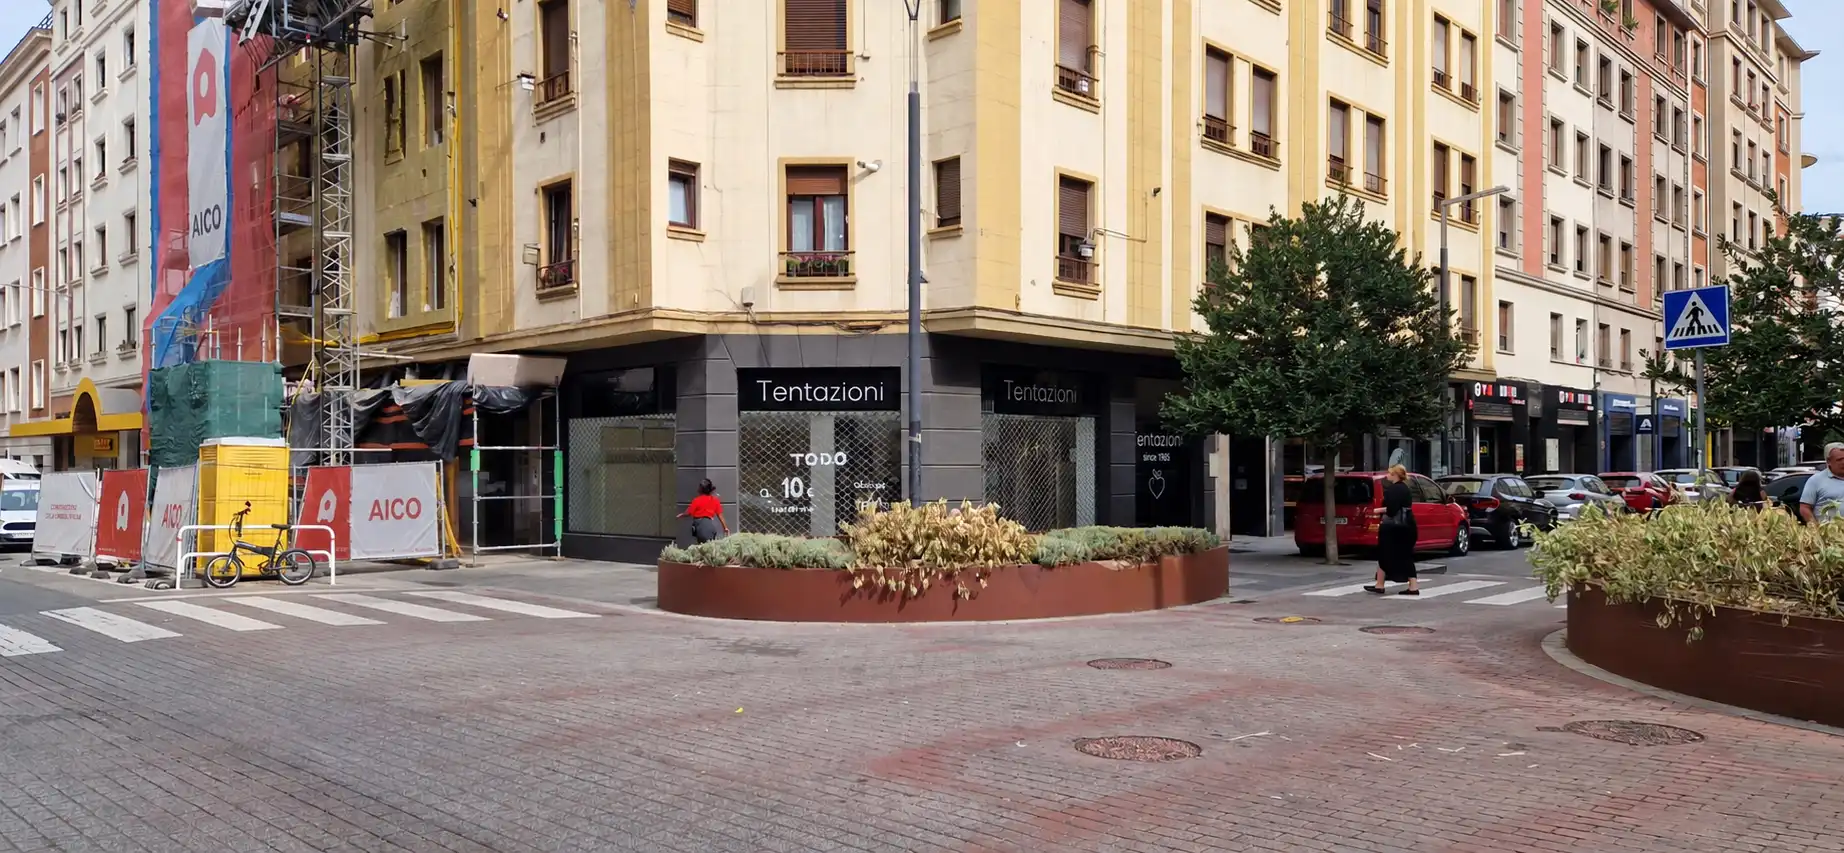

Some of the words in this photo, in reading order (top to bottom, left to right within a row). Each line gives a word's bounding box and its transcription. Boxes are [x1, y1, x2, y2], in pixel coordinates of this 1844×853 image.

[192, 203, 222, 239] AICO
[756, 380, 884, 402] Tentazioni
[1003, 379, 1077, 403] Tentazioni
[1136, 432, 1184, 447] entazioni
[789, 451, 848, 468] TODO
[781, 476, 804, 499] 10
[368, 497, 422, 521] AICO
